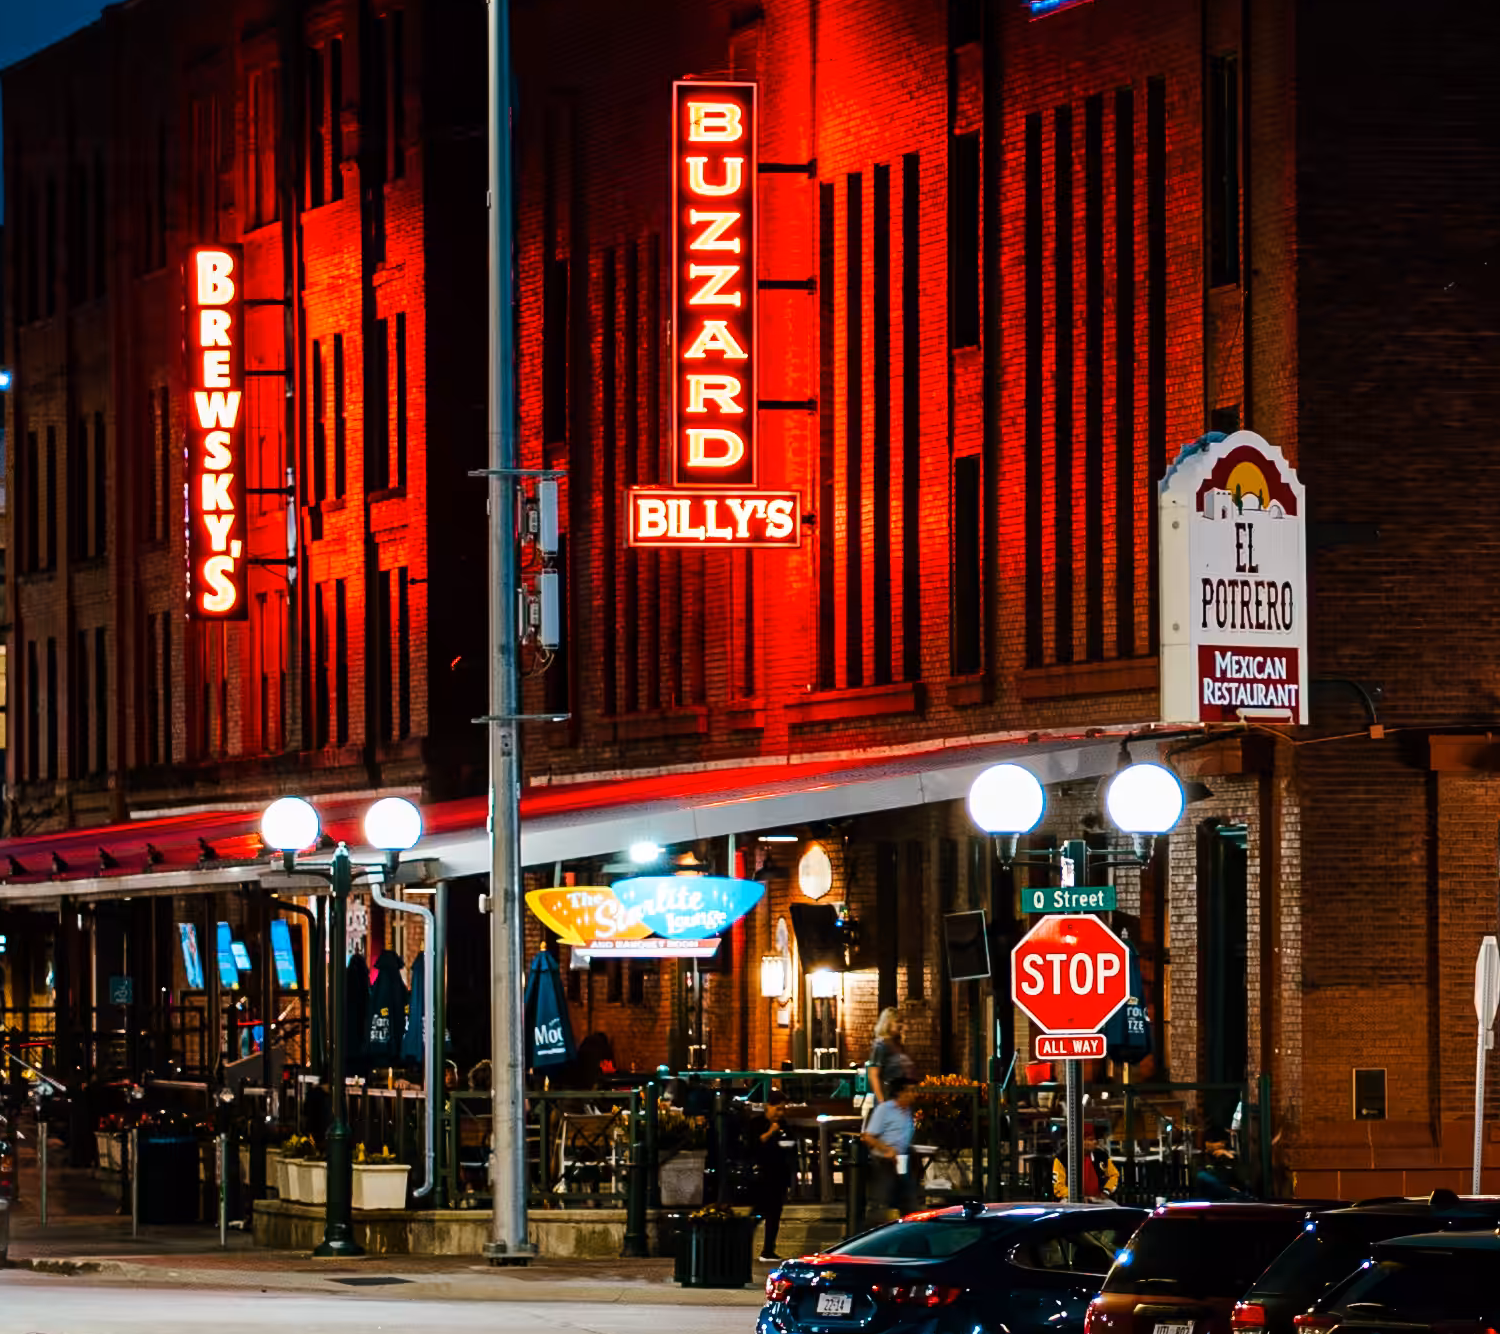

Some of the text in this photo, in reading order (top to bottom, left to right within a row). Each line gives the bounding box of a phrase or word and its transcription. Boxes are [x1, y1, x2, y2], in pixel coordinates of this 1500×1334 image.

[684, 102, 748, 467] BUZZARD
[194, 251, 242, 612] BREWSKY'S
[637, 498, 794, 541] BILLY'S
[1235, 522, 1259, 574] EL
[1201, 577, 1294, 631] POTRERO
[1214, 650, 1287, 680] MEXICAN
[1203, 677, 1298, 708] RESTAURANT
[567, 890, 604, 909] The
[594, 881, 705, 939] Starlite
[1033, 889, 1105, 909] Q Street
[665, 910, 727, 934] Lounge
[1021, 952, 1121, 996] STOP
[1043, 1039, 1099, 1054] ALL WAY
